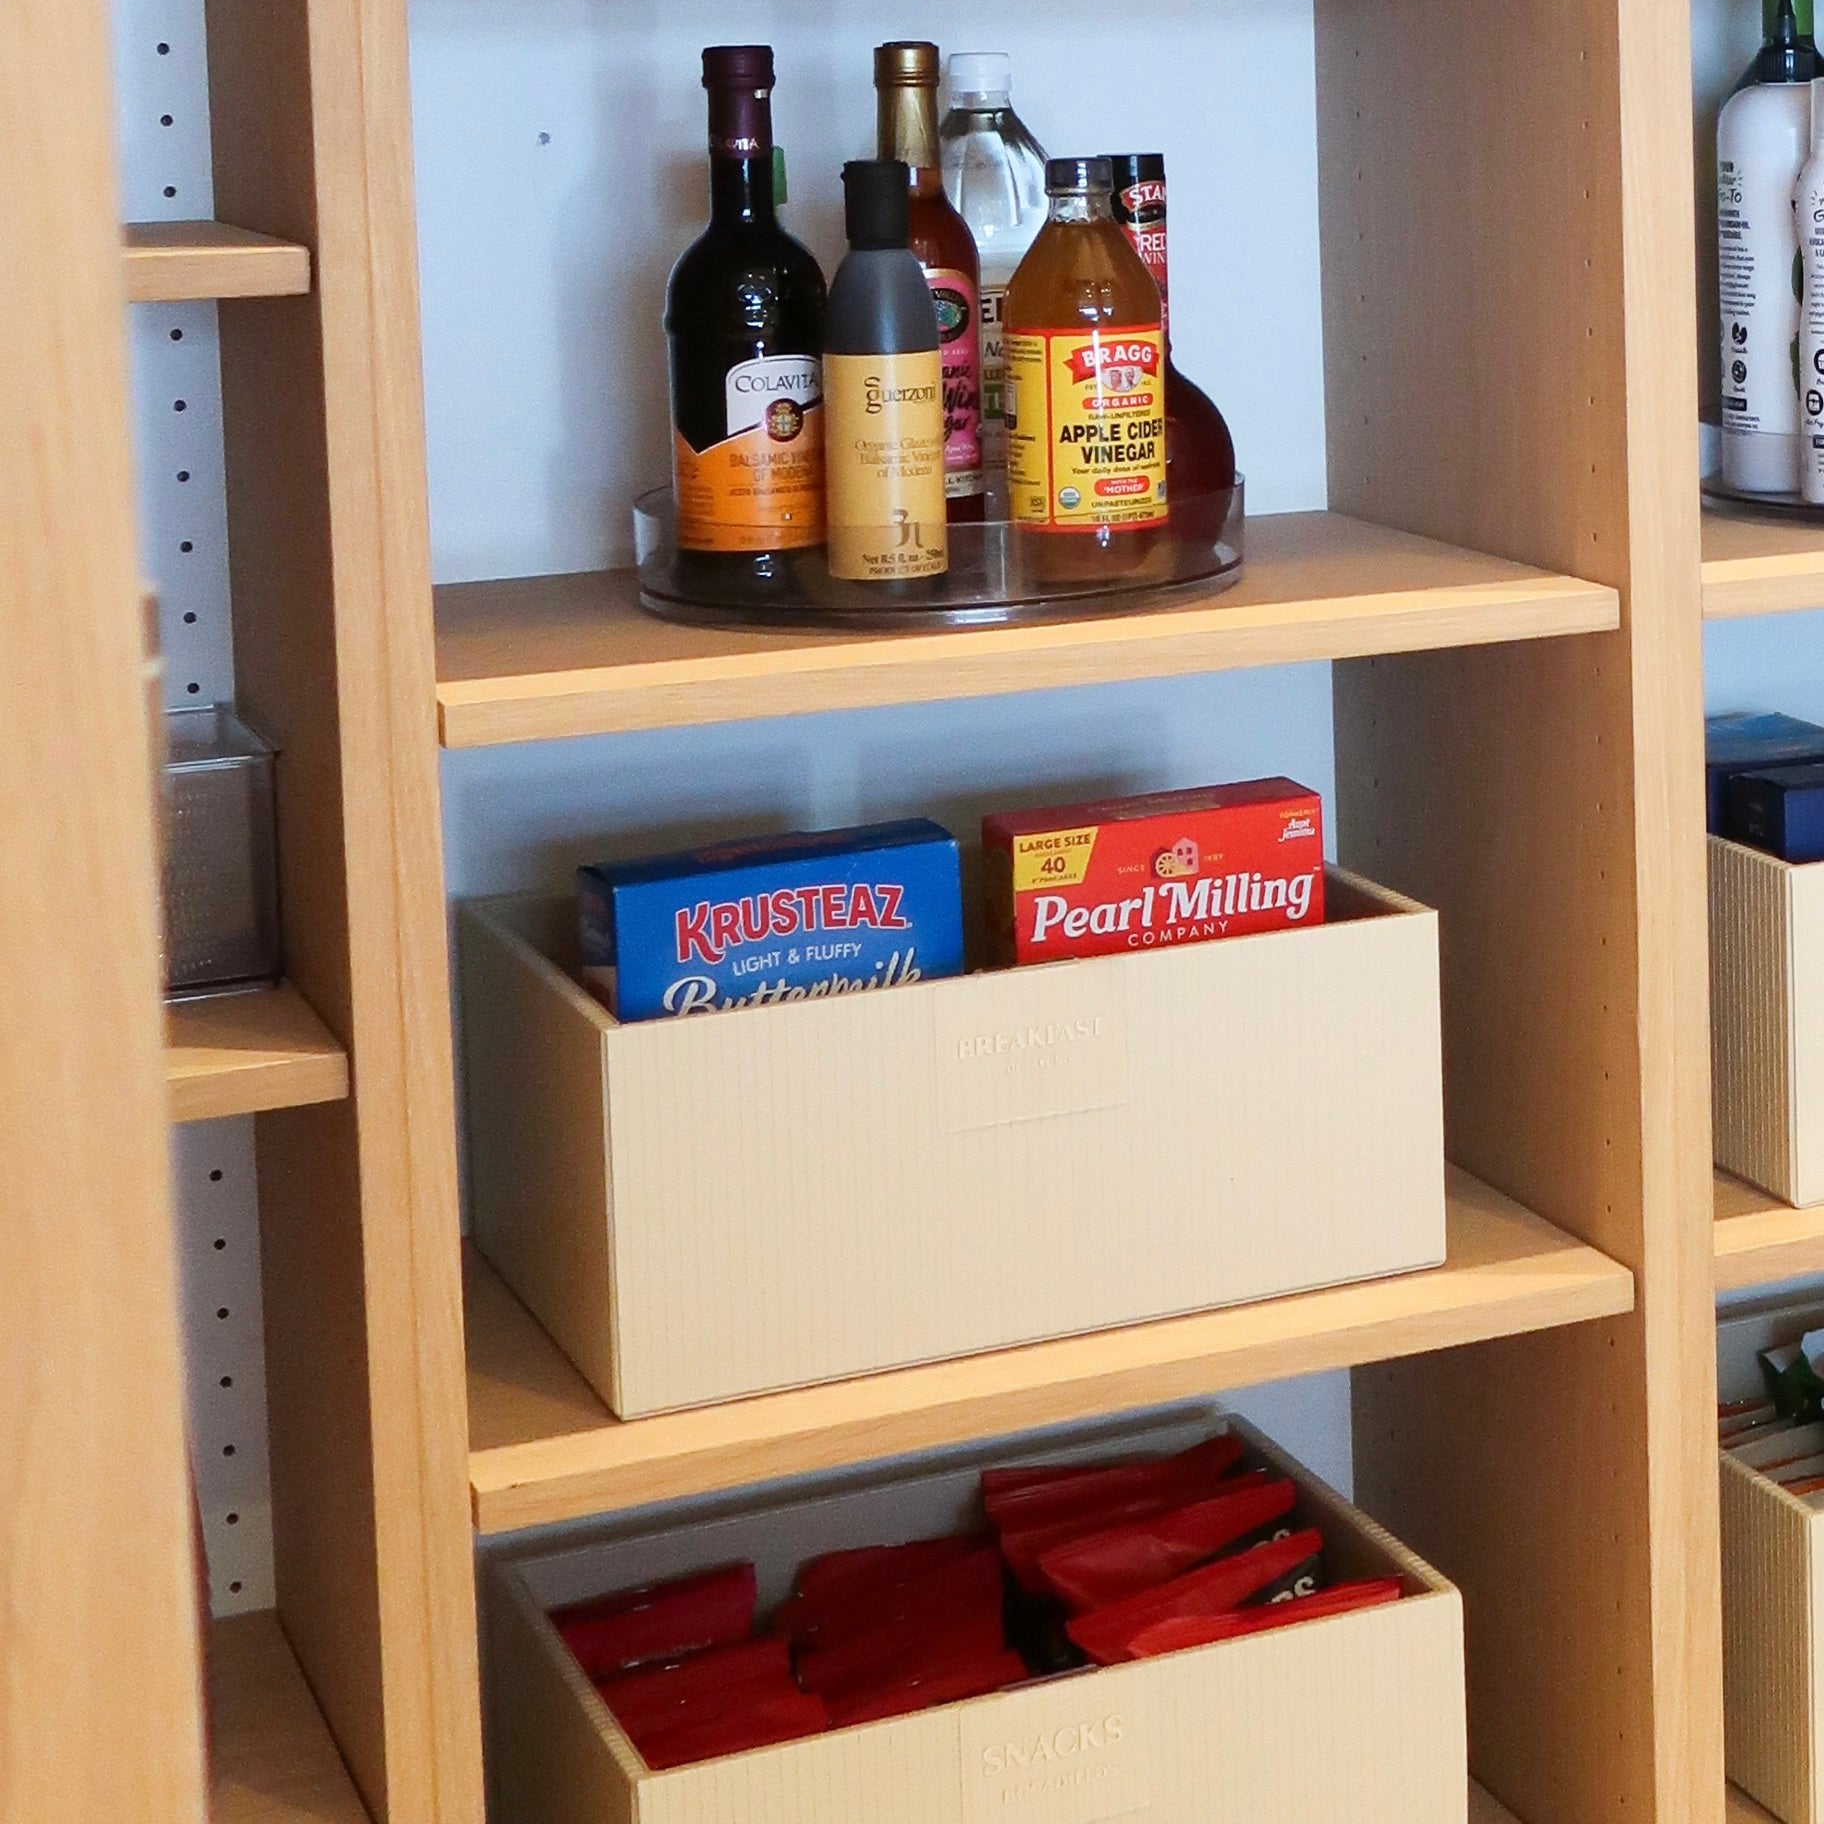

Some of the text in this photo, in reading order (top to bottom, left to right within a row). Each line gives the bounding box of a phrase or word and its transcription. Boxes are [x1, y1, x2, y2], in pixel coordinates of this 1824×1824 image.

[1082, 345, 1152, 368] BRAGG
[735, 373, 817, 394] COLAVITA
[1091, 395, 1148, 408] ORGANIC
[1059, 418, 1163, 443] APPLE CIDER
[1081, 441, 1156, 464] VINEGAR
[1072, 467, 1089, 475] Your
[1091, 466, 1111, 476] daily
[1113, 465, 1131, 473] dose
[1277, 827, 1316, 843] Jemima
[1288, 818, 1310, 830] Aunt
[1019, 832, 1091, 854] LARGE SIZE
[1040, 857, 1065, 873] 40
[1117, 864, 1145, 875] SINCE
[1031, 871, 1316, 944] Pearl Milling
[675, 883, 907, 965] KRUSTEAZ
[1127, 920, 1229, 948] COMPANY
[732, 942, 863, 977] LIGHT & FLUFFY
[957, 1015, 1099, 1061] BREAKFAST
[981, 1713, 1122, 1778] SNACKS
